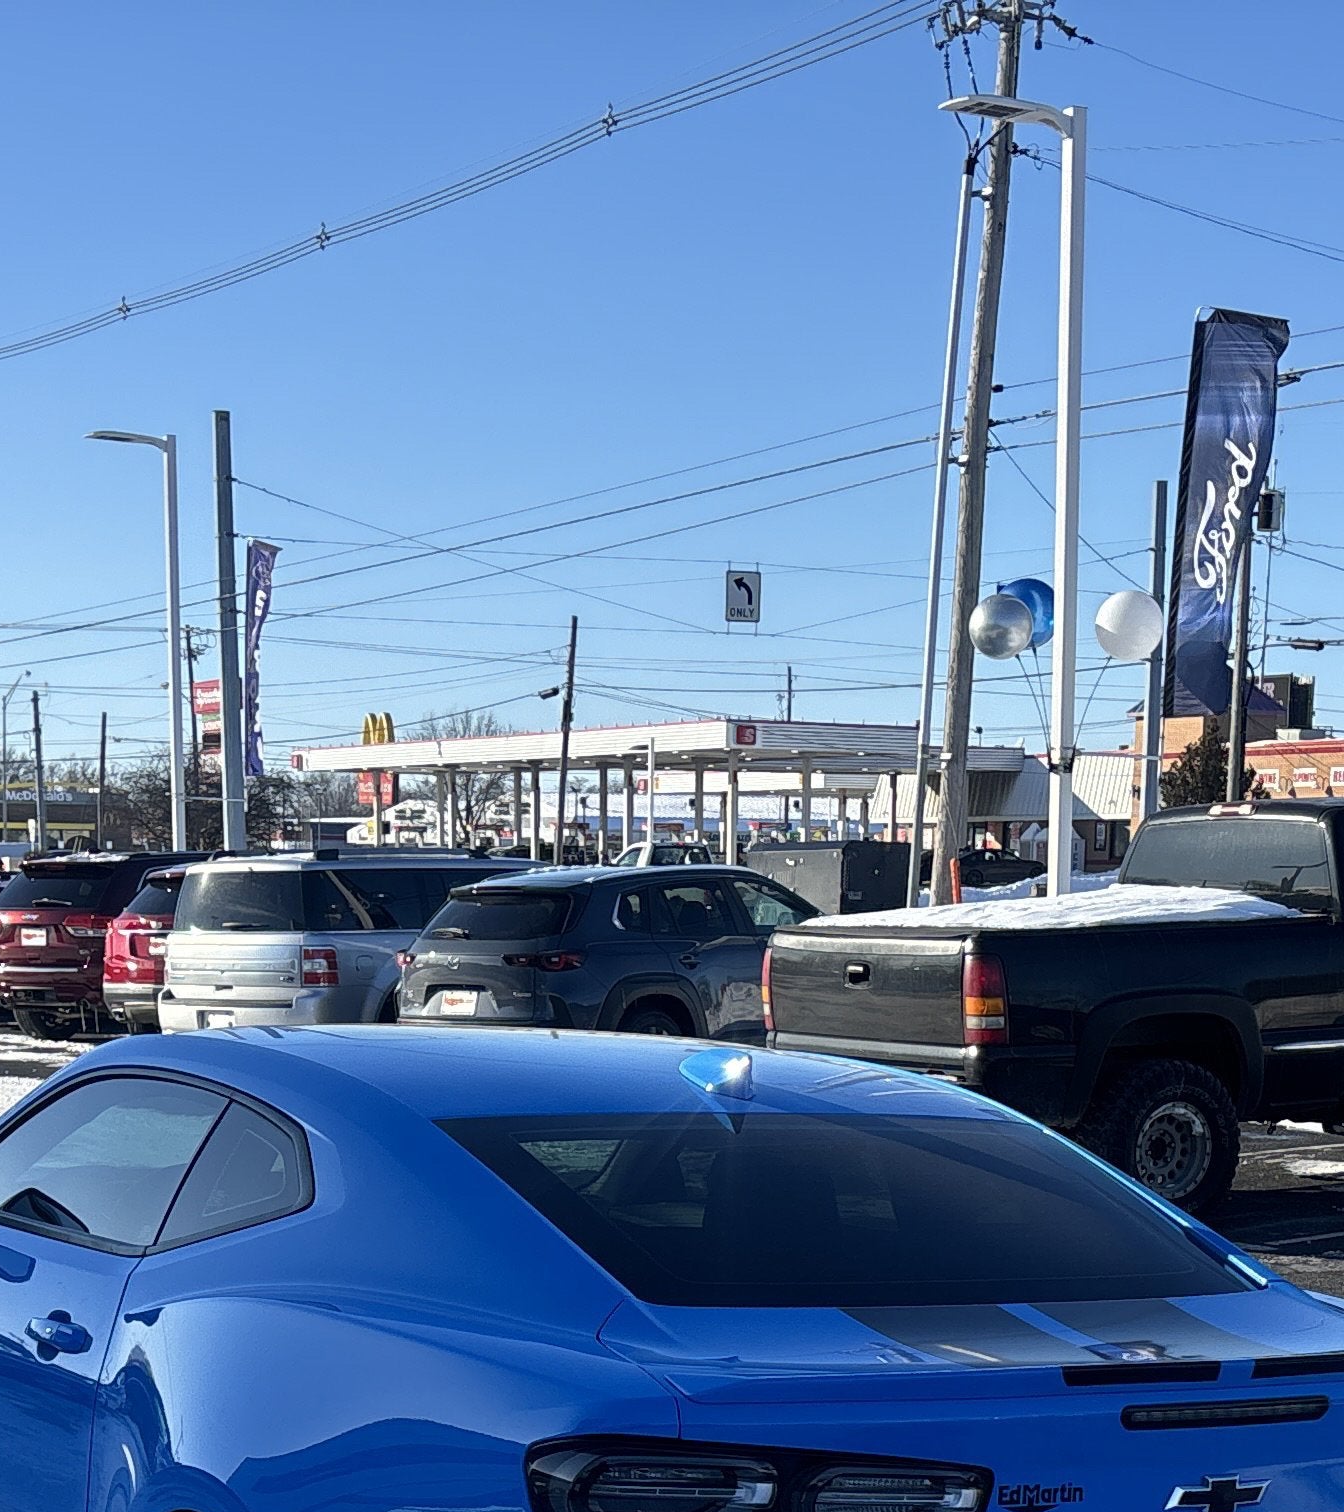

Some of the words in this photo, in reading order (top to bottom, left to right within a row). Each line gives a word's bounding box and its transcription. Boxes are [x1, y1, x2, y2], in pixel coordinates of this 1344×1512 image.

[1193, 437, 1256, 604] Ford
[729, 607, 755, 618] ONLY
[5, 790, 74, 802] McDoald's
[997, 1482, 1084, 1506] EdMartin
